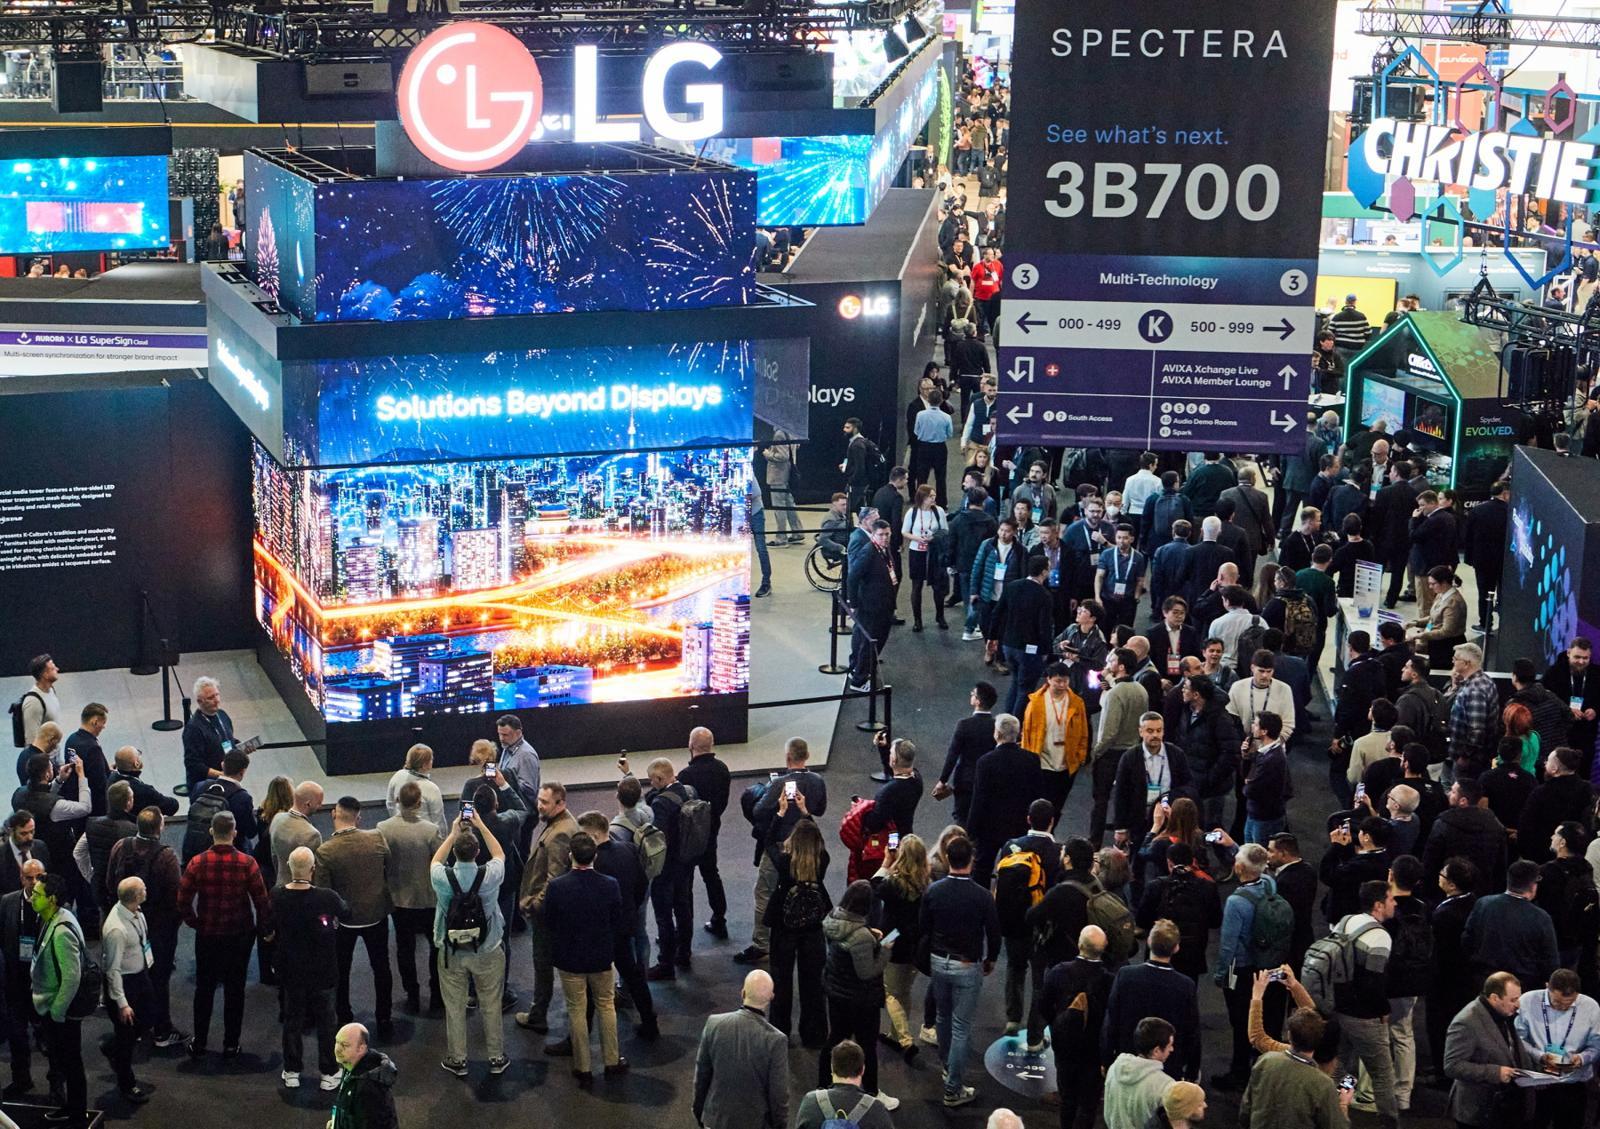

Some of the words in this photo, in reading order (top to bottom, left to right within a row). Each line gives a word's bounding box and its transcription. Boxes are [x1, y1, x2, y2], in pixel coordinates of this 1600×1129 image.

[1051, 28, 1288, 58] SPECTERA
[574, 41, 724, 142] LG
[1047, 124, 1087, 143] See
[1095, 125, 1167, 144] what's
[1175, 128, 1229, 145] next.
[1364, 117, 1595, 203] CHRISTIE
[1044, 161, 1280, 221] 3B700
[1100, 272, 1218, 289] Multi-Technology
[862, 295, 891, 316] LG
[1058, 318, 1084, 330] 000
[1096, 319, 1121, 331] 499
[1148, 316, 1164, 337] K
[1190, 321, 1216, 333] 500
[1229, 322, 1254, 334] 999
[75, 336, 87, 344] LG
[90, 336, 133, 346] SuperSign
[1162, 364, 1192, 373] AVIXA
[1194, 365, 1236, 376] Xchange
[1238, 366, 1258, 374] Live
[1162, 376, 1192, 384] AVIXA
[1194, 376, 1233, 386] Member
[1236, 378, 1272, 388] Lounge
[377, 393, 501, 420] Solutions
[507, 386, 605, 418] Beyond
[611, 382, 722, 413] Displays
[1465, 426, 1514, 436] EVOLVED.
